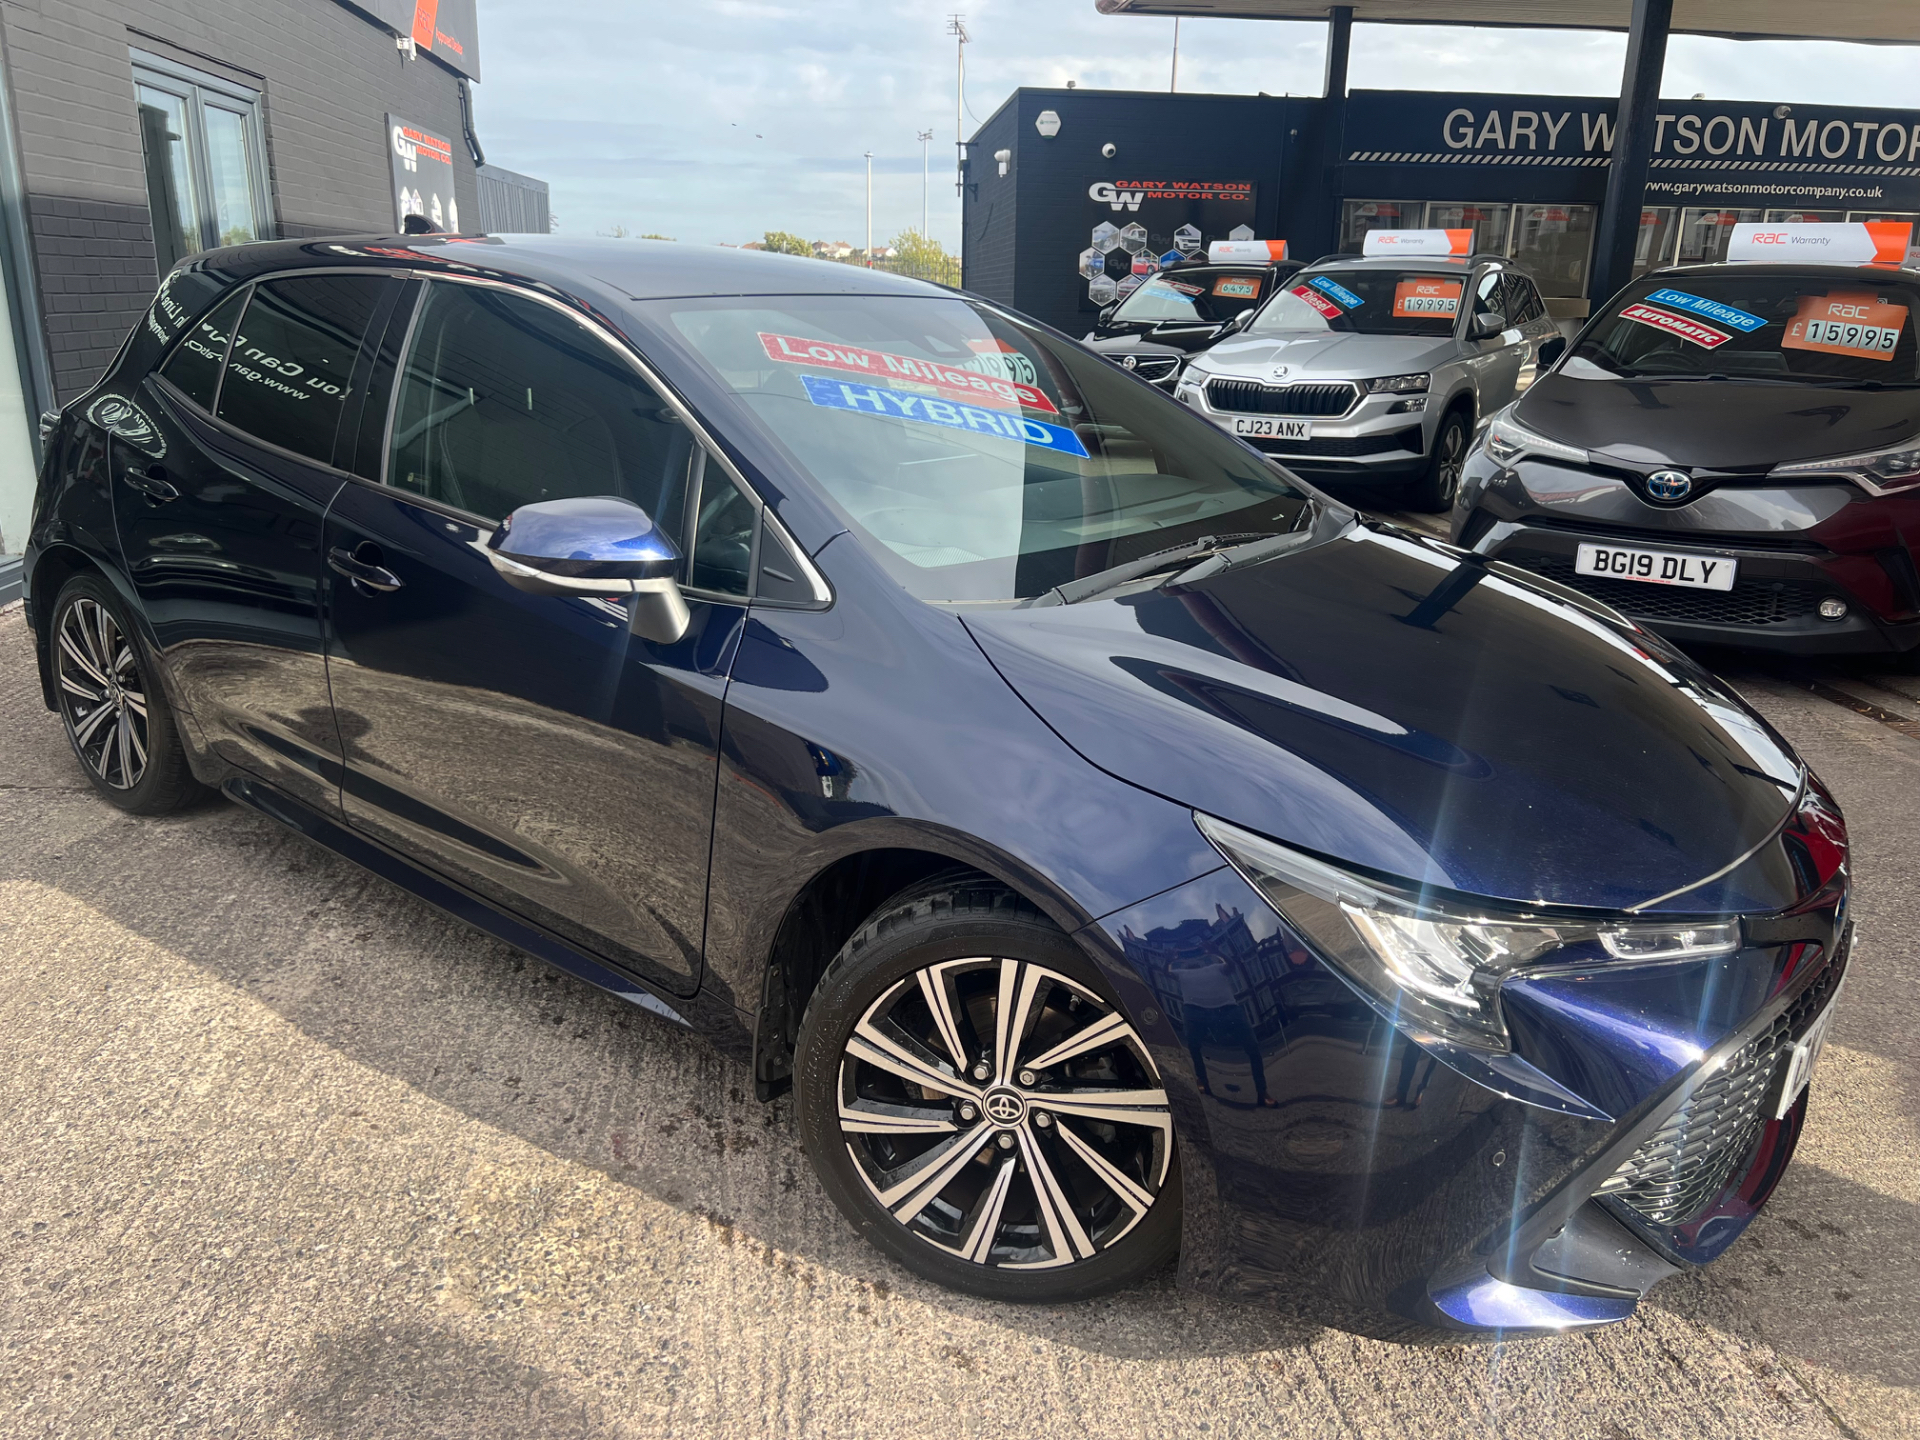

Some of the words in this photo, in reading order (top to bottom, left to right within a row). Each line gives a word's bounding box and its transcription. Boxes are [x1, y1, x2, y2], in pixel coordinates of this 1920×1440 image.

[402, 126, 423, 142] GARY
[423, 134, 451, 153] WATSON
[1443, 108, 1571, 150] GARY
[1582, 113, 1768, 156] WTSON
[416, 145, 441, 161] MOTOR
[1115, 180, 1167, 189] GARY
[1172, 182, 1250, 191] WATSON
[1645, 181, 1883, 199] ww.garywatsonmotorcompany.co.uk
[1088, 182, 1144, 211] GW
[1147, 191, 1213, 200] MOTOR
[1218, 192, 1249, 201] CO.
[1377, 236, 1400, 244] RAC
[1400, 238, 1424, 246] Warranty
[1752, 233, 1789, 245] RAC
[1791, 236, 1831, 247] Warranty
[1314, 276, 1333, 288] Low
[1329, 284, 1358, 305] Mileage
[1416, 285, 1441, 295] RAC
[1301, 291, 1332, 311] Diesel
[1655, 289, 1693, 306] Low
[1692, 297, 1755, 327] Mileage
[1827, 303, 1870, 319] RAC
[1629, 307, 1720, 344] AUTOMATIC
[776, 337, 869, 367] Low
[881, 353, 1039, 403] Mileage
[838, 384, 1054, 444] HYBRID
[1236, 419, 1272, 435] CJ23
[1276, 421, 1305, 437] ANX
[1593, 549, 1653, 577] BG19
[1660, 556, 1717, 583] DLY
